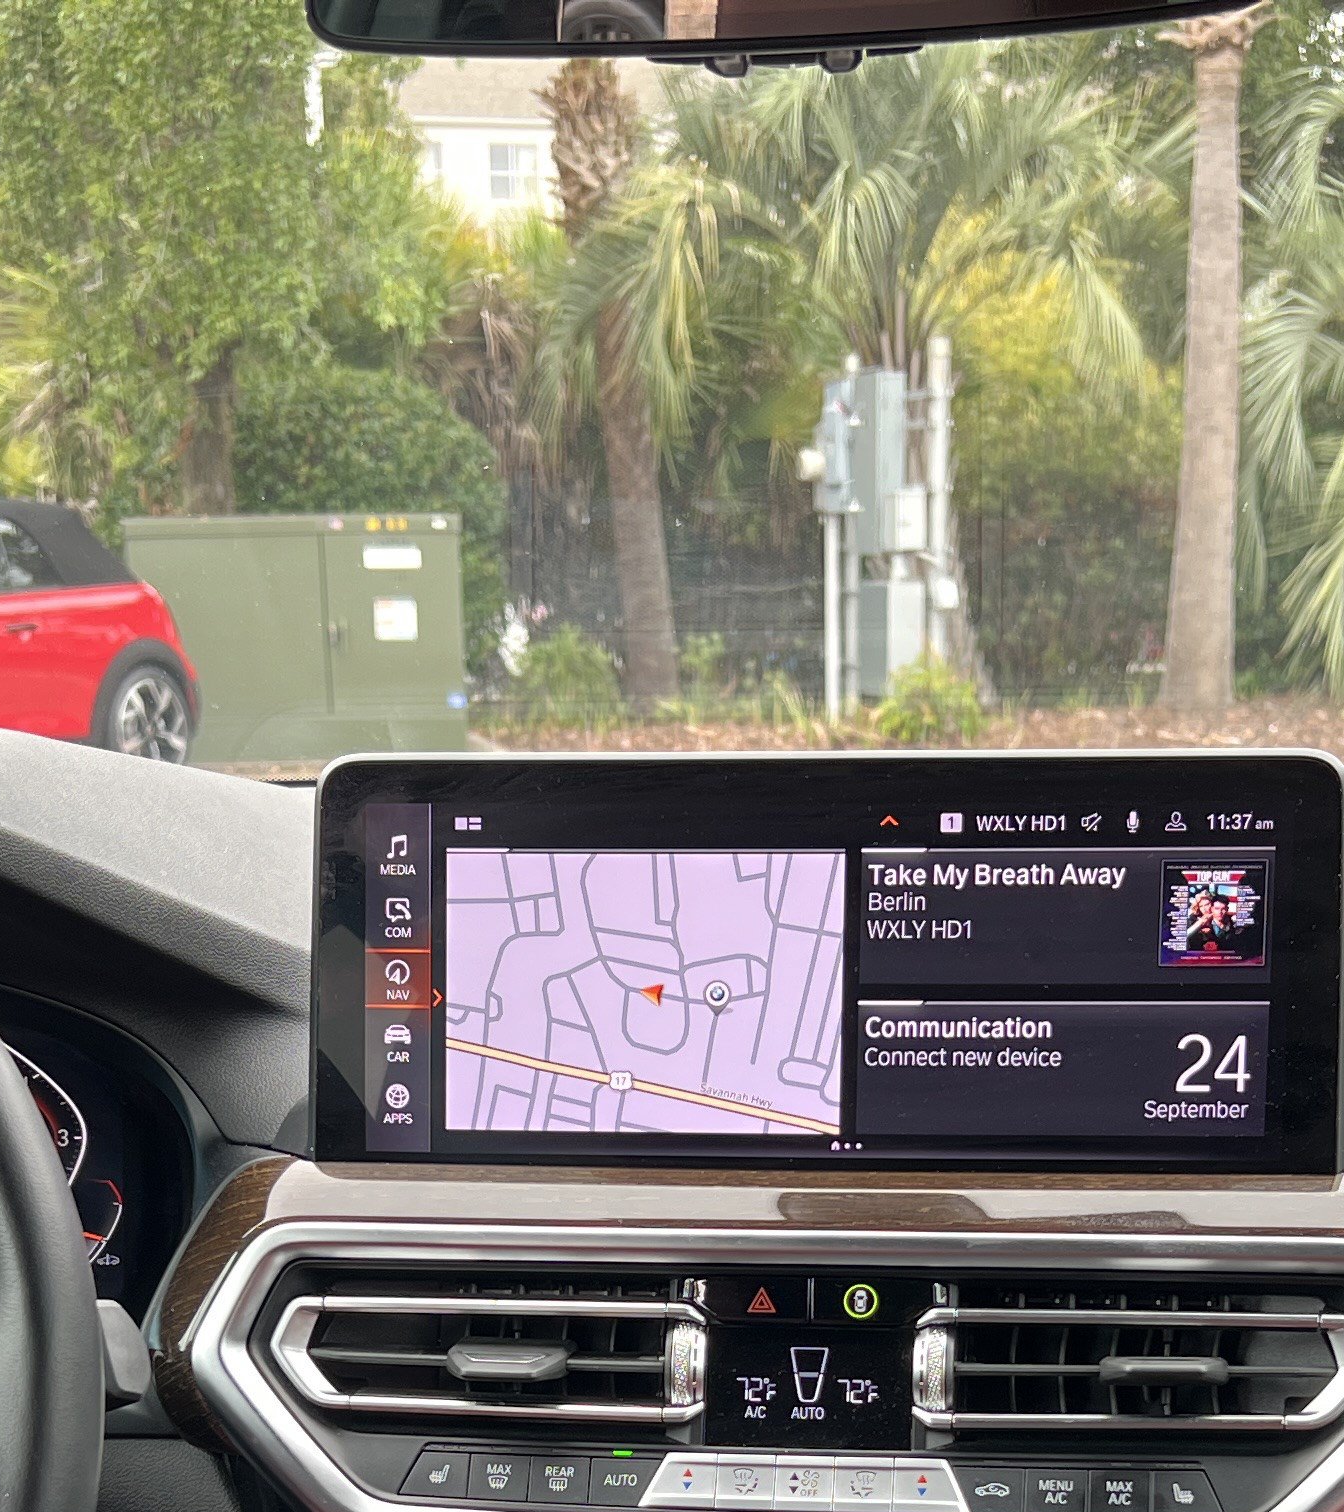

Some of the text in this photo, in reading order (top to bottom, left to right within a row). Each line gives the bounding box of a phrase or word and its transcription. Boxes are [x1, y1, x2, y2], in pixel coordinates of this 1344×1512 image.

[946, 815, 1067, 832] 1 WXLY HD1
[1207, 814, 1274, 831] 11:37 am
[380, 863, 416, 876] MEDIA
[868, 863, 1126, 890] Take My Breath Away
[868, 891, 926, 911] Berlin
[384, 927, 412, 939] COM
[867, 919, 973, 940] WXLY HD1
[386, 989, 410, 1001] NAV
[864, 1016, 1053, 1040] Communication
[386, 1051, 410, 1064] CAR
[864, 1047, 1062, 1067] Connect new device
[1174, 1034, 1251, 1094] 24
[614, 1075, 627, 1087] 17
[700, 1083, 773, 1110] Savannah Hwy
[1143, 1100, 1249, 1121] September
[383, 1112, 413, 1126] APPS
[57, 1128, 69, 1148] 3
[736, 1377, 777, 1402] 72°F
[837, 1379, 879, 1404] 72°F
[744, 1406, 767, 1419] A/C
[791, 1406, 825, 1420] AUTO
[486, 1464, 512, 1476] MAX
[545, 1466, 575, 1478] REAR
[604, 1474, 638, 1487] AUTO
[1039, 1479, 1074, 1492] MENU
[1106, 1481, 1133, 1493] MAX
[800, 1488, 818, 1498] OFF
[1045, 1492, 1067, 1505] A/C
[1108, 1493, 1132, 1506] A/C
